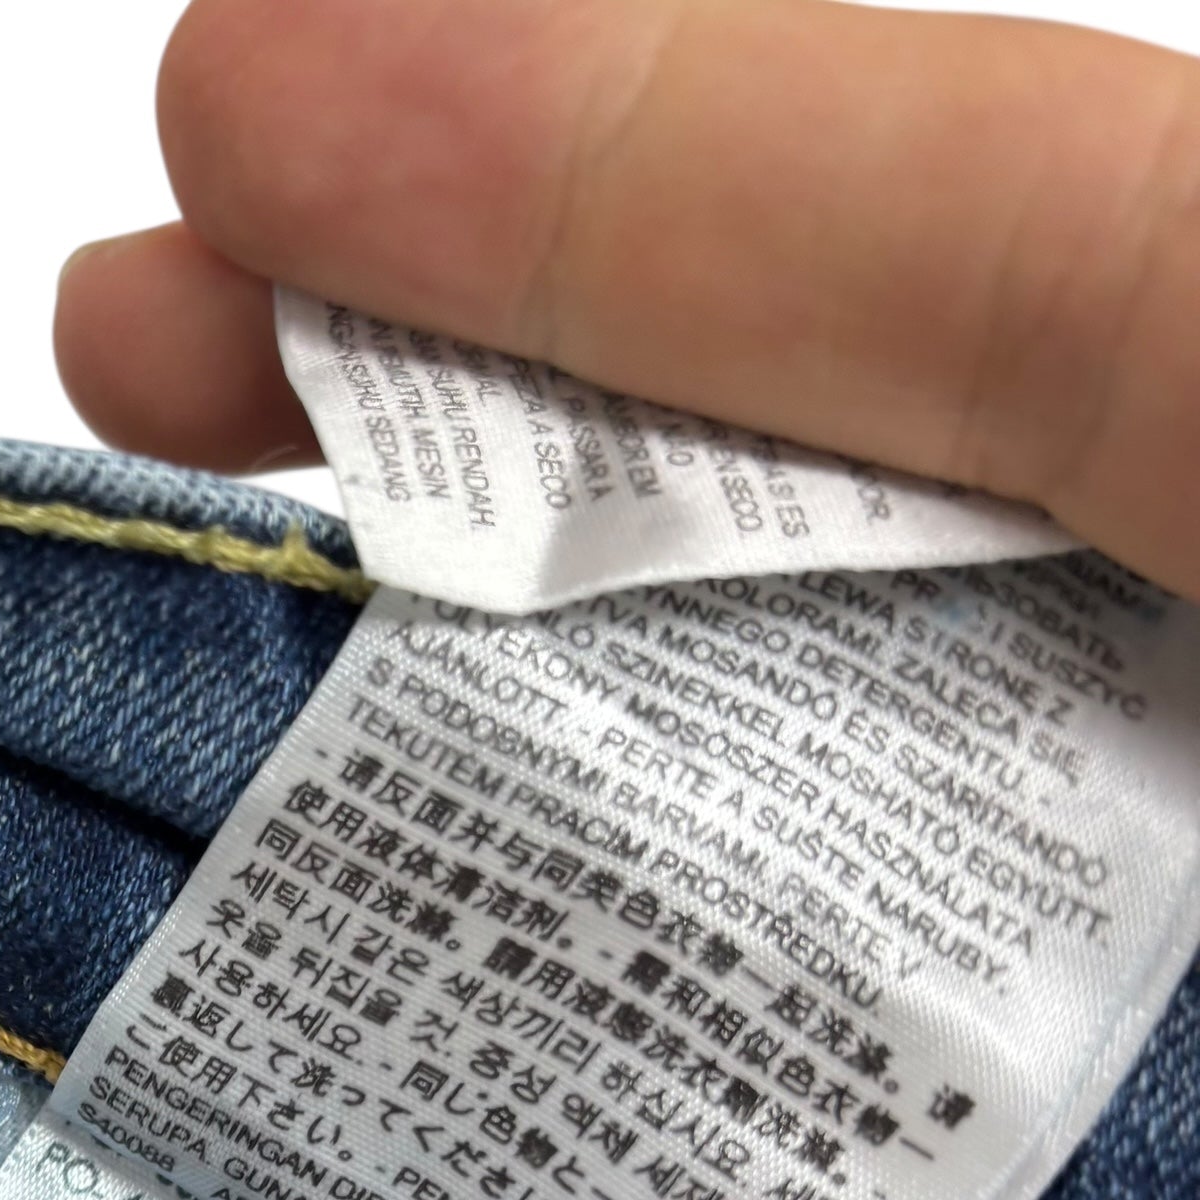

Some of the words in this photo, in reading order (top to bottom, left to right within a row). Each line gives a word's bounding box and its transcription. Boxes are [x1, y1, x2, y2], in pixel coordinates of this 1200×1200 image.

[364, 411, 410, 506] SEDANG
[410, 424, 452, 504] MESIN
[527, 414, 553, 438] A
[532, 437, 573, 512] SECO
[558, 393, 610, 483] PASSAR
[587, 482, 615, 502] A
[626, 462, 662, 501] EM
[775, 500, 810, 542] ES
[629, 578, 794, 658] YNNEGO
[693, 570, 890, 665] OLORAMI.
[893, 654, 1025, 745] ZALECA
[656, 624, 842, 725] MOSANDÓ
[840, 706, 894, 756] ÉS
[1043, 694, 1076, 727] Z
[343, 694, 507, 801] TEKUTÉM
[600, 640, 793, 747] SZINEKKEL
[794, 732, 967, 860] MOSHATÓ
[364, 654, 397, 690] S
[776, 870, 893, 964] PERTE
[892, 952, 923, 984] V
[596, 724, 718, 802] PERTE
[718, 785, 748, 816] A
[863, 880, 1016, 996] NARUBY.
[821, 798, 1041, 958] HASZNÁLATA
[175, 930, 375, 1069] 사용하세요.
[435, 962, 600, 1077] 색상끼리
[72, 1101, 177, 1173] S40088
[85, 1074, 219, 1166] SERUPA.
[101, 1044, 328, 1189] PENGERINGAN
